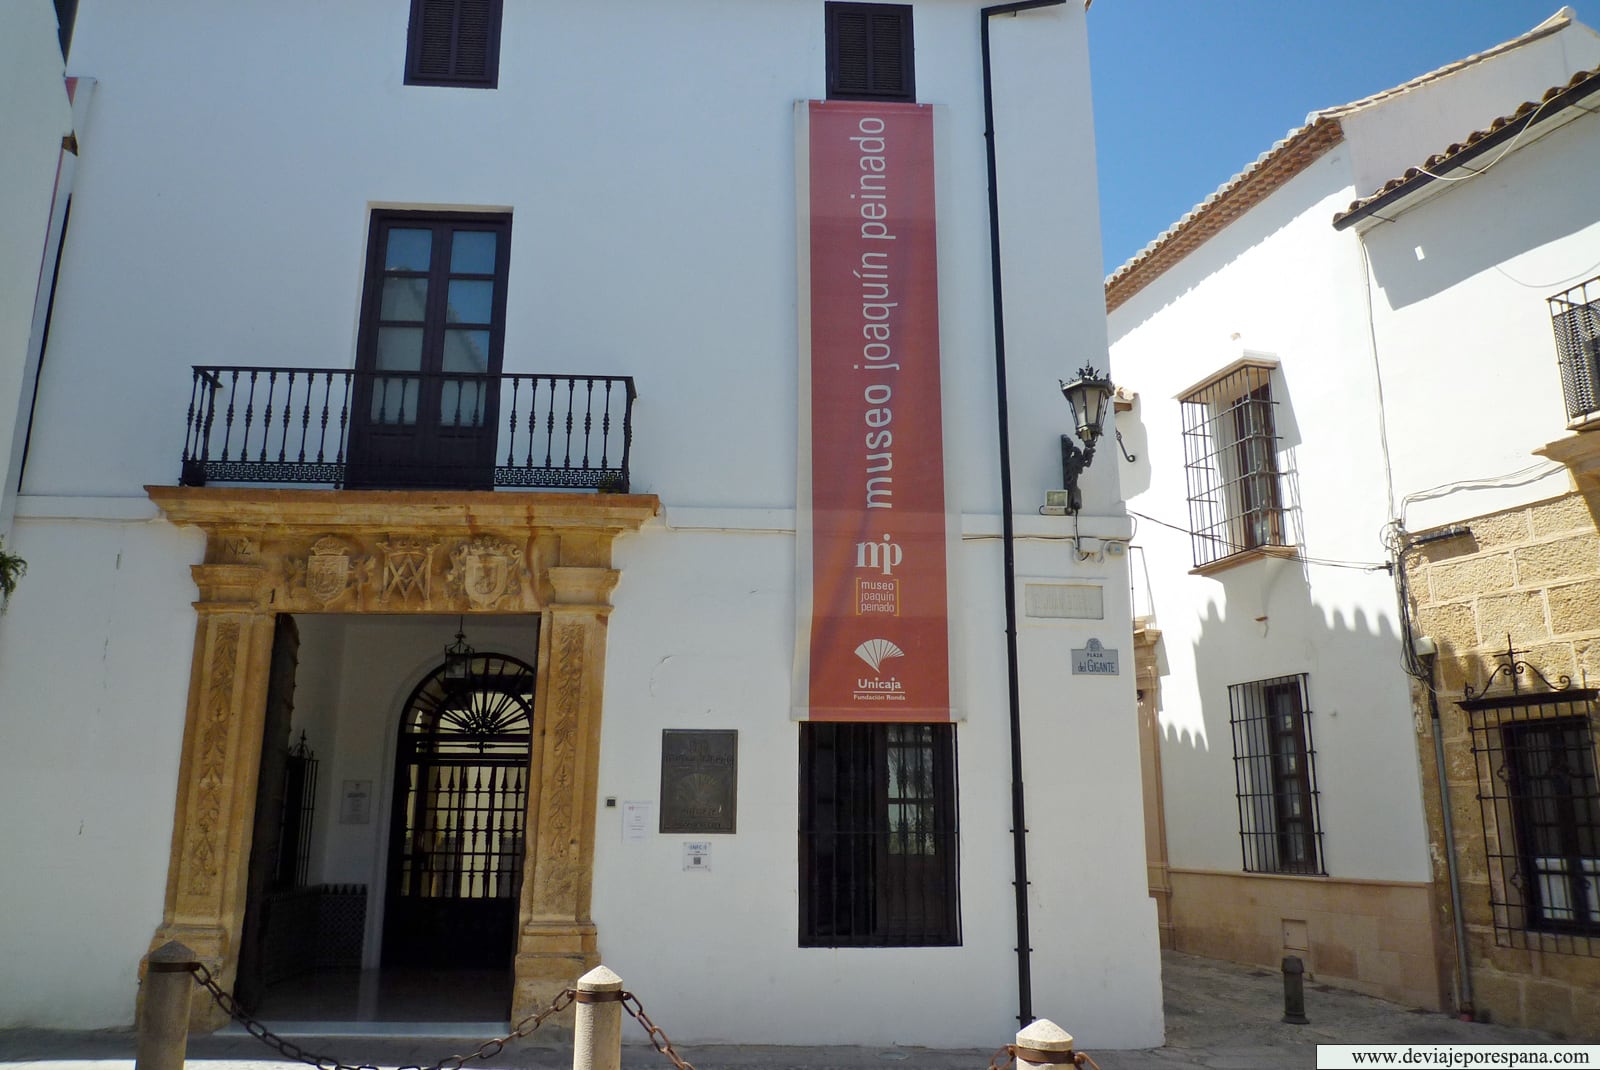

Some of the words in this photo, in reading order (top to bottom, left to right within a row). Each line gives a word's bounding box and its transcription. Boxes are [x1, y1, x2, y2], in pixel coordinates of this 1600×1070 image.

[850, 117, 896, 240] peinado
[853, 253, 900, 370] joaquín
[864, 384, 892, 509] museo
[861, 581, 894, 591] museo
[861, 591, 895, 603] joaquín
[861, 602, 895, 613] peinado
[1088, 659, 1115, 672] GIGANTE
[857, 677, 902, 691] Unicaja
